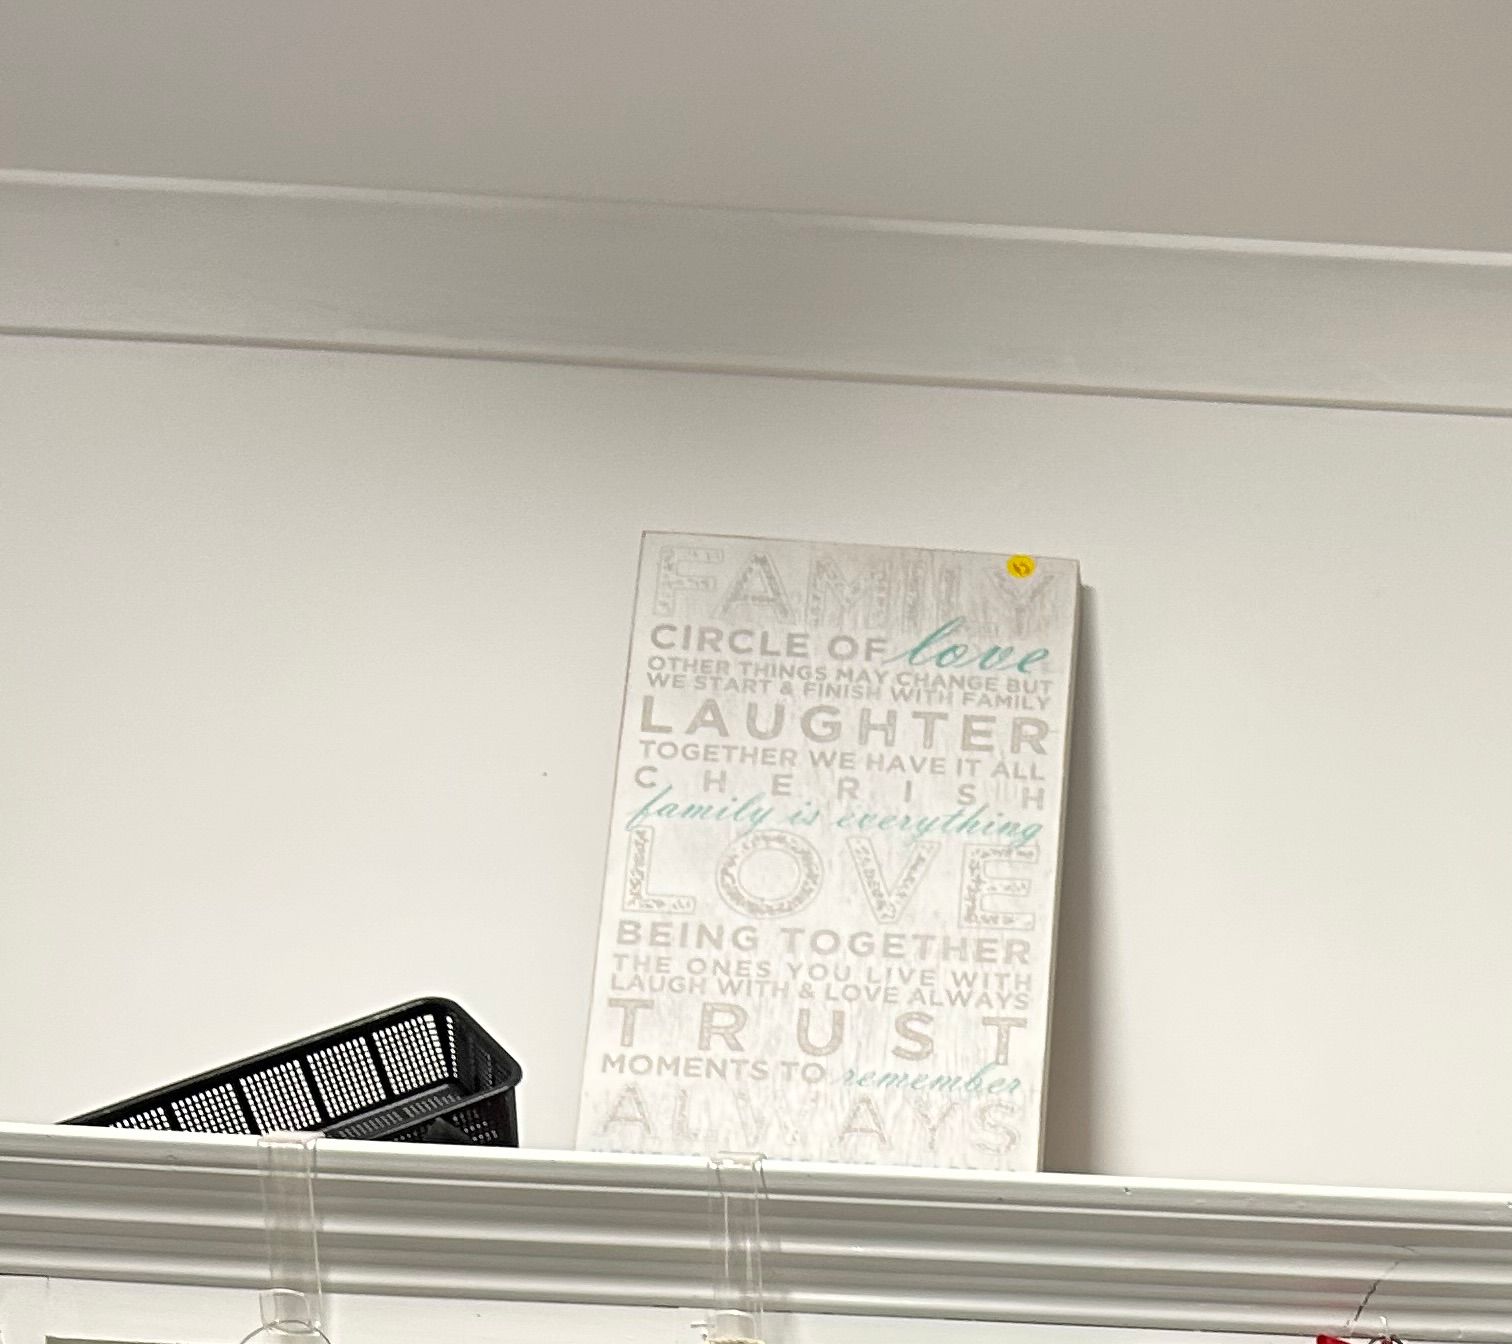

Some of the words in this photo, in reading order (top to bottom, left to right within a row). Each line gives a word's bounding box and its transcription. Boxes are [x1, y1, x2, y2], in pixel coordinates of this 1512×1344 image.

[650, 623, 809, 658] CIRCLE
[827, 634, 890, 663] OF
[884, 615, 1050, 674] love
[648, 655, 735, 678] OTHER
[740, 658, 829, 681] THINGS
[835, 666, 885, 686] MAY
[894, 670, 996, 693] CHANGE
[1006, 678, 1053, 694] BUT
[641, 695, 1050, 756] LAUGHTER
[640, 740, 796, 768] TOGETHER
[809, 749, 857, 770] WE
[866, 754, 945, 775] HAVE
[958, 759, 981, 776] IT
[991, 762, 1046, 781] ALL
[622, 825, 1039, 930] LOVE
[617, 920, 759, 951] BEING
[781, 927, 1031, 965] TOGETHER
[611, 972, 706, 994] LAUGH
[716, 977, 789, 998] WITH
[799, 982, 816, 1000] &
[825, 982, 897, 1003] LOVE
[906, 986, 1029, 1011] ALWAYS
[607, 998, 1027, 1066] TRUST
[602, 1054, 768, 1081] MOMENTS
[781, 1063, 825, 1084] TO
[837, 1061, 1021, 1094] remember
